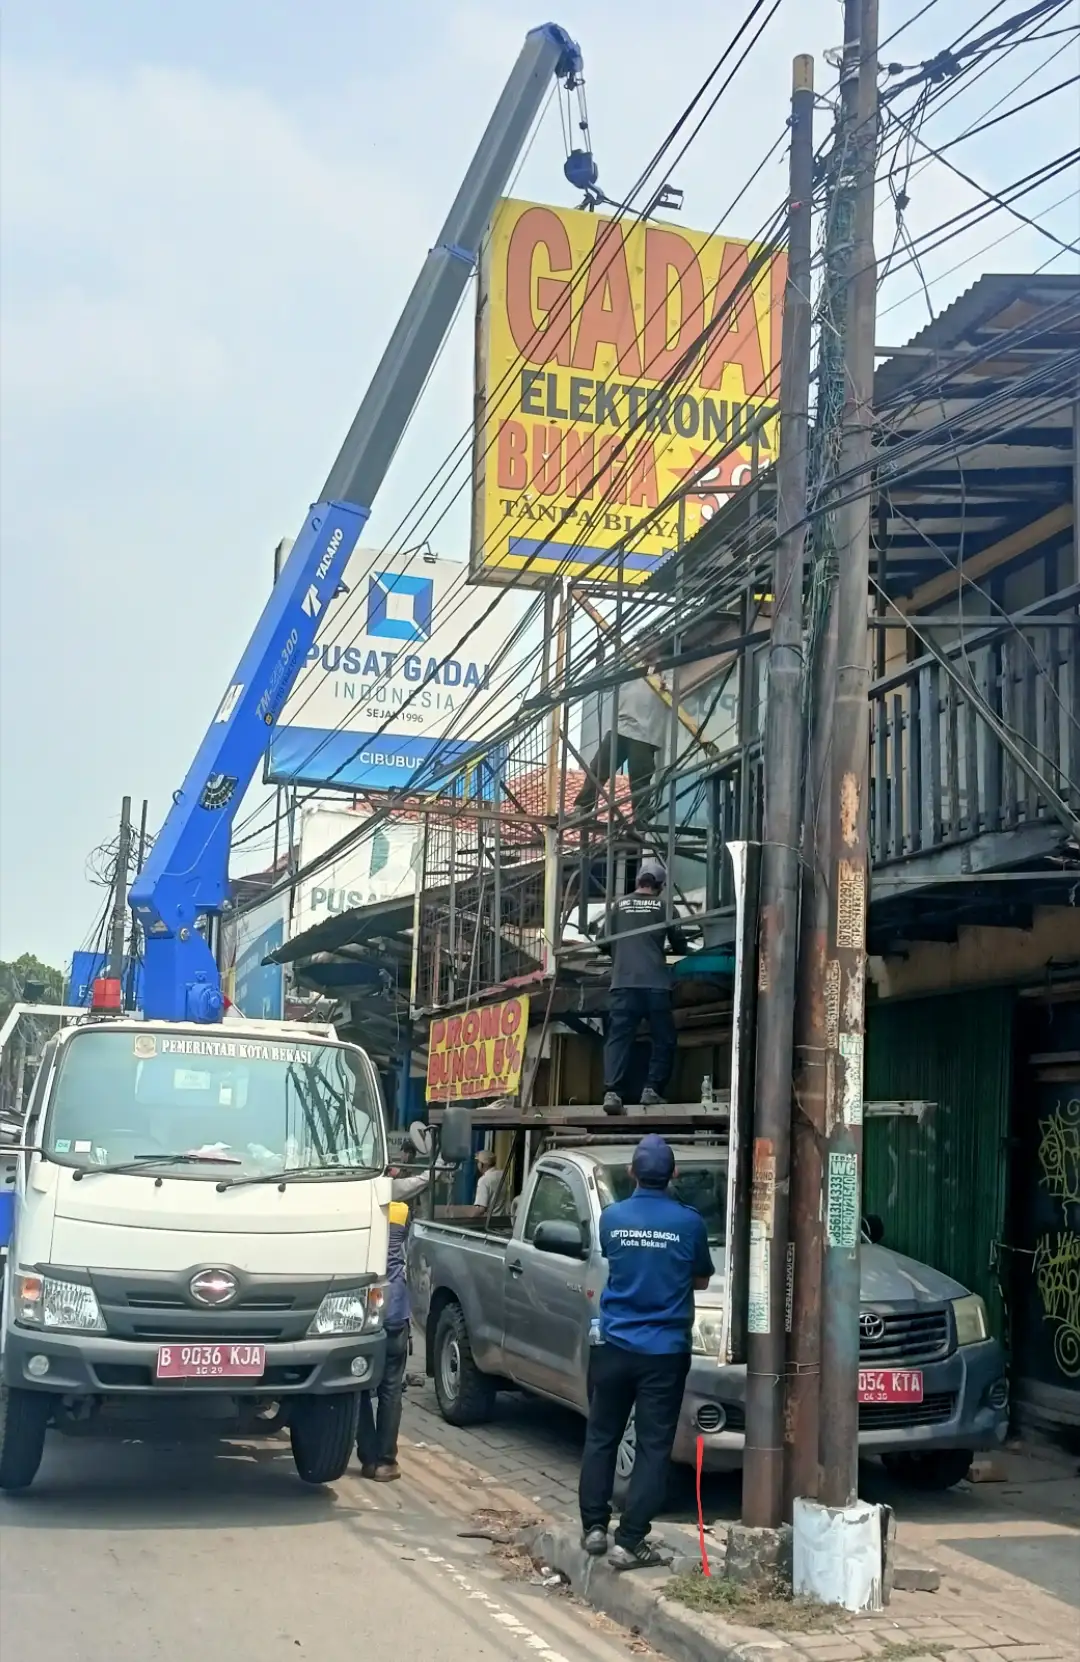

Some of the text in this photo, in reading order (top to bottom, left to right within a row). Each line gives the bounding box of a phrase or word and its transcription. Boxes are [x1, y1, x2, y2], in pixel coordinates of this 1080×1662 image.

[521, 369, 772, 449] ELEKTRONIK
[498, 418, 660, 509] BUNGA
[500, 499, 681, 539] TANPA BIAYA
[316, 528, 344, 580] TADANO
[302, 643, 490, 691] PUSAT GADAI
[334, 680, 455, 710] INDONESIA
[366, 708, 424, 723] SEJAK 1996
[430, 999, 522, 1053] PROMO
[161, 1039, 312, 1065] PEMERINTAH KOTA BEKASI
[427, 1034, 521, 1086] BUNGA 5%
[832, 1161, 855, 1176] WC
[610, 1229, 680, 1242] UPTD DINAS BMSDA
[620, 1239, 668, 1248] Kota Bekasi
[161, 1346, 261, 1366] B 9036 KJA
[892, 1373, 920, 1391] KTA
